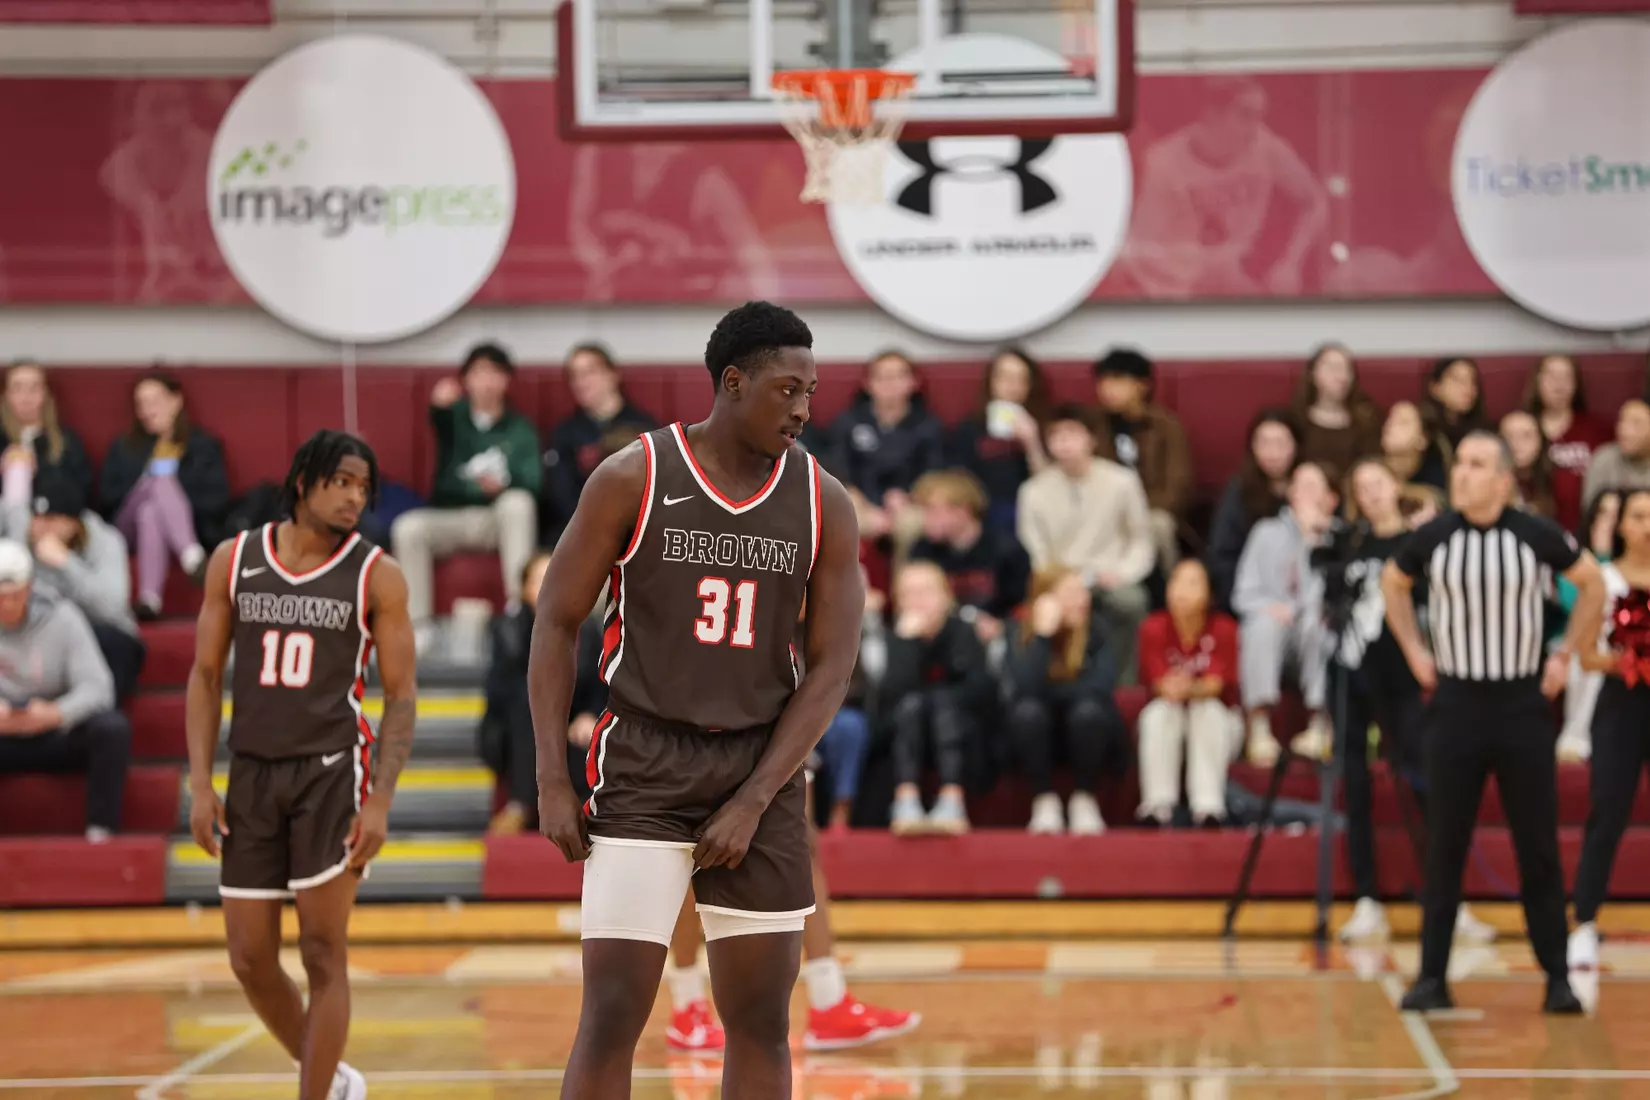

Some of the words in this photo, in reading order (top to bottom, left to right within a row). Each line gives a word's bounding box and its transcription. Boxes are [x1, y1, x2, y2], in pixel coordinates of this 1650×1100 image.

[219, 182, 506, 237] imagepress
[662, 527, 798, 575] BROWN
[237, 592, 353, 631] BROWN
[693, 575, 758, 648] 31
[259, 629, 315, 688] 10
